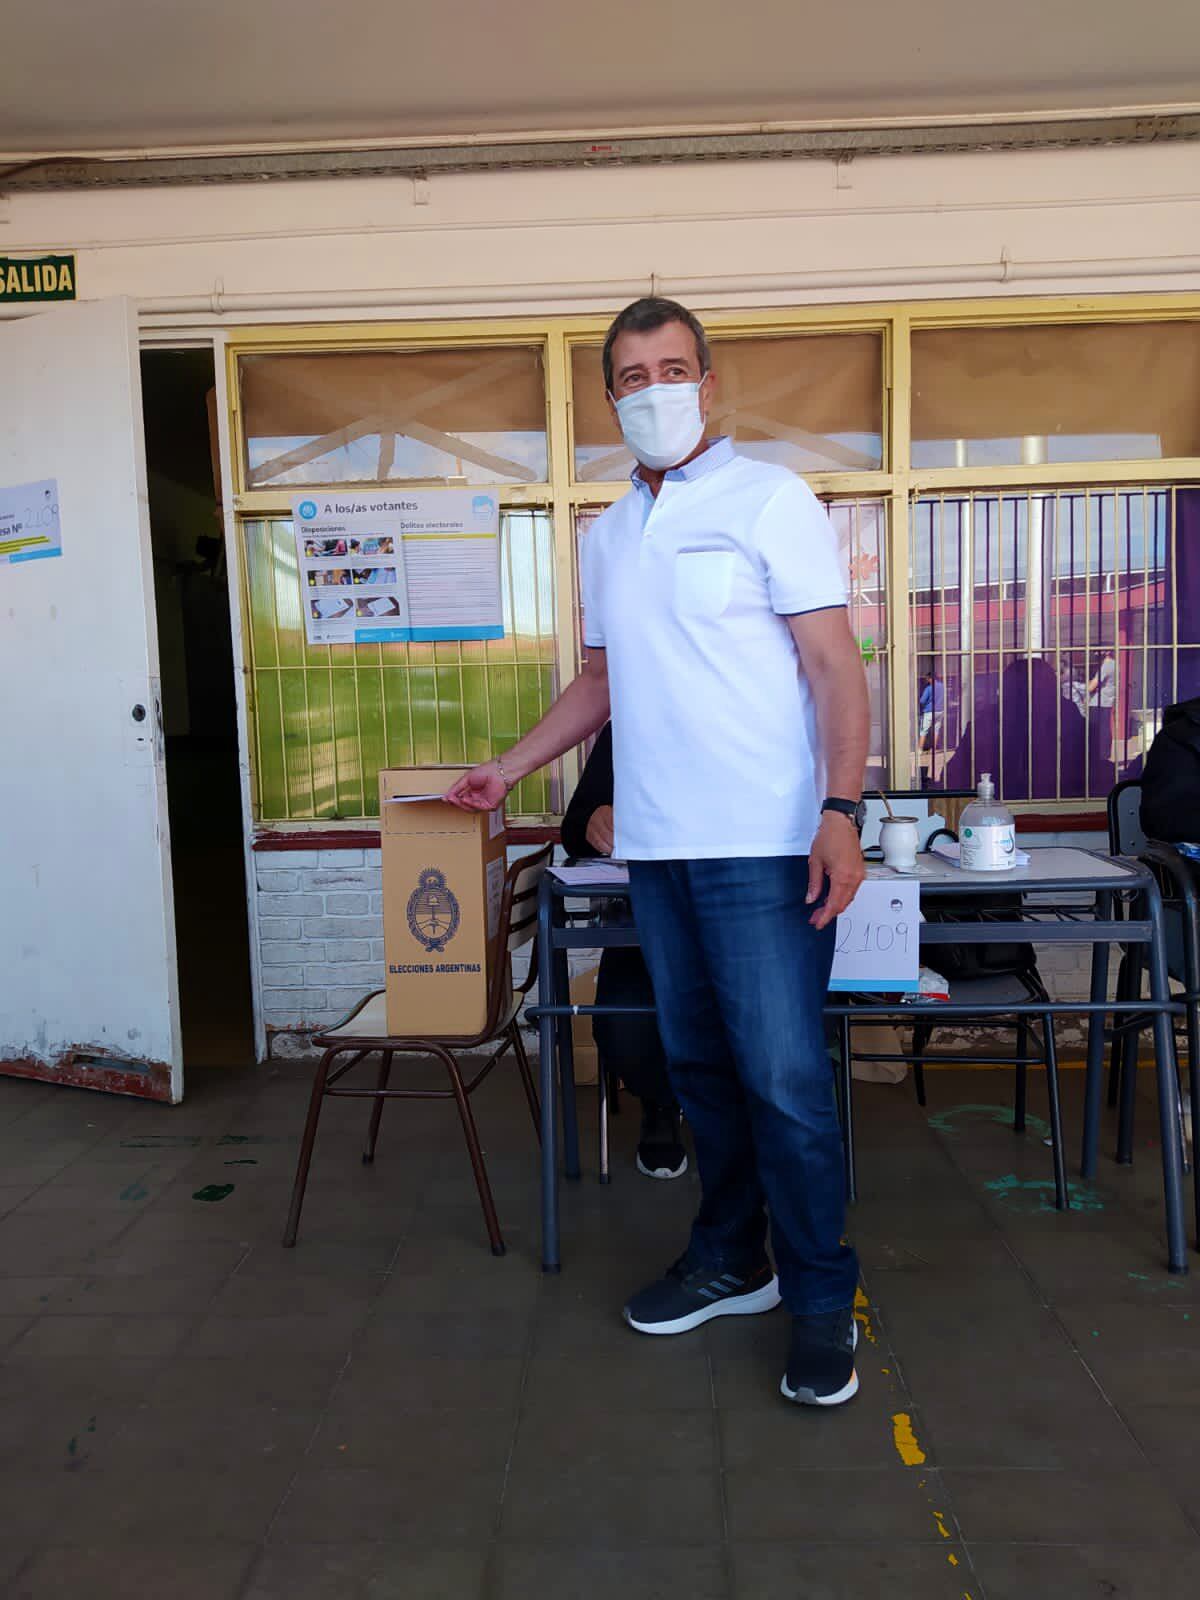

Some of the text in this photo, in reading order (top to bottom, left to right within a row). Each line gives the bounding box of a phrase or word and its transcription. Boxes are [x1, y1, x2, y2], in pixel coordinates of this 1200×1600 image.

[324, 501, 418, 514] A los/as votantes
[835, 916, 909, 954] 2109
[389, 963, 481, 974] ELECCIONES ARGENTINAS
